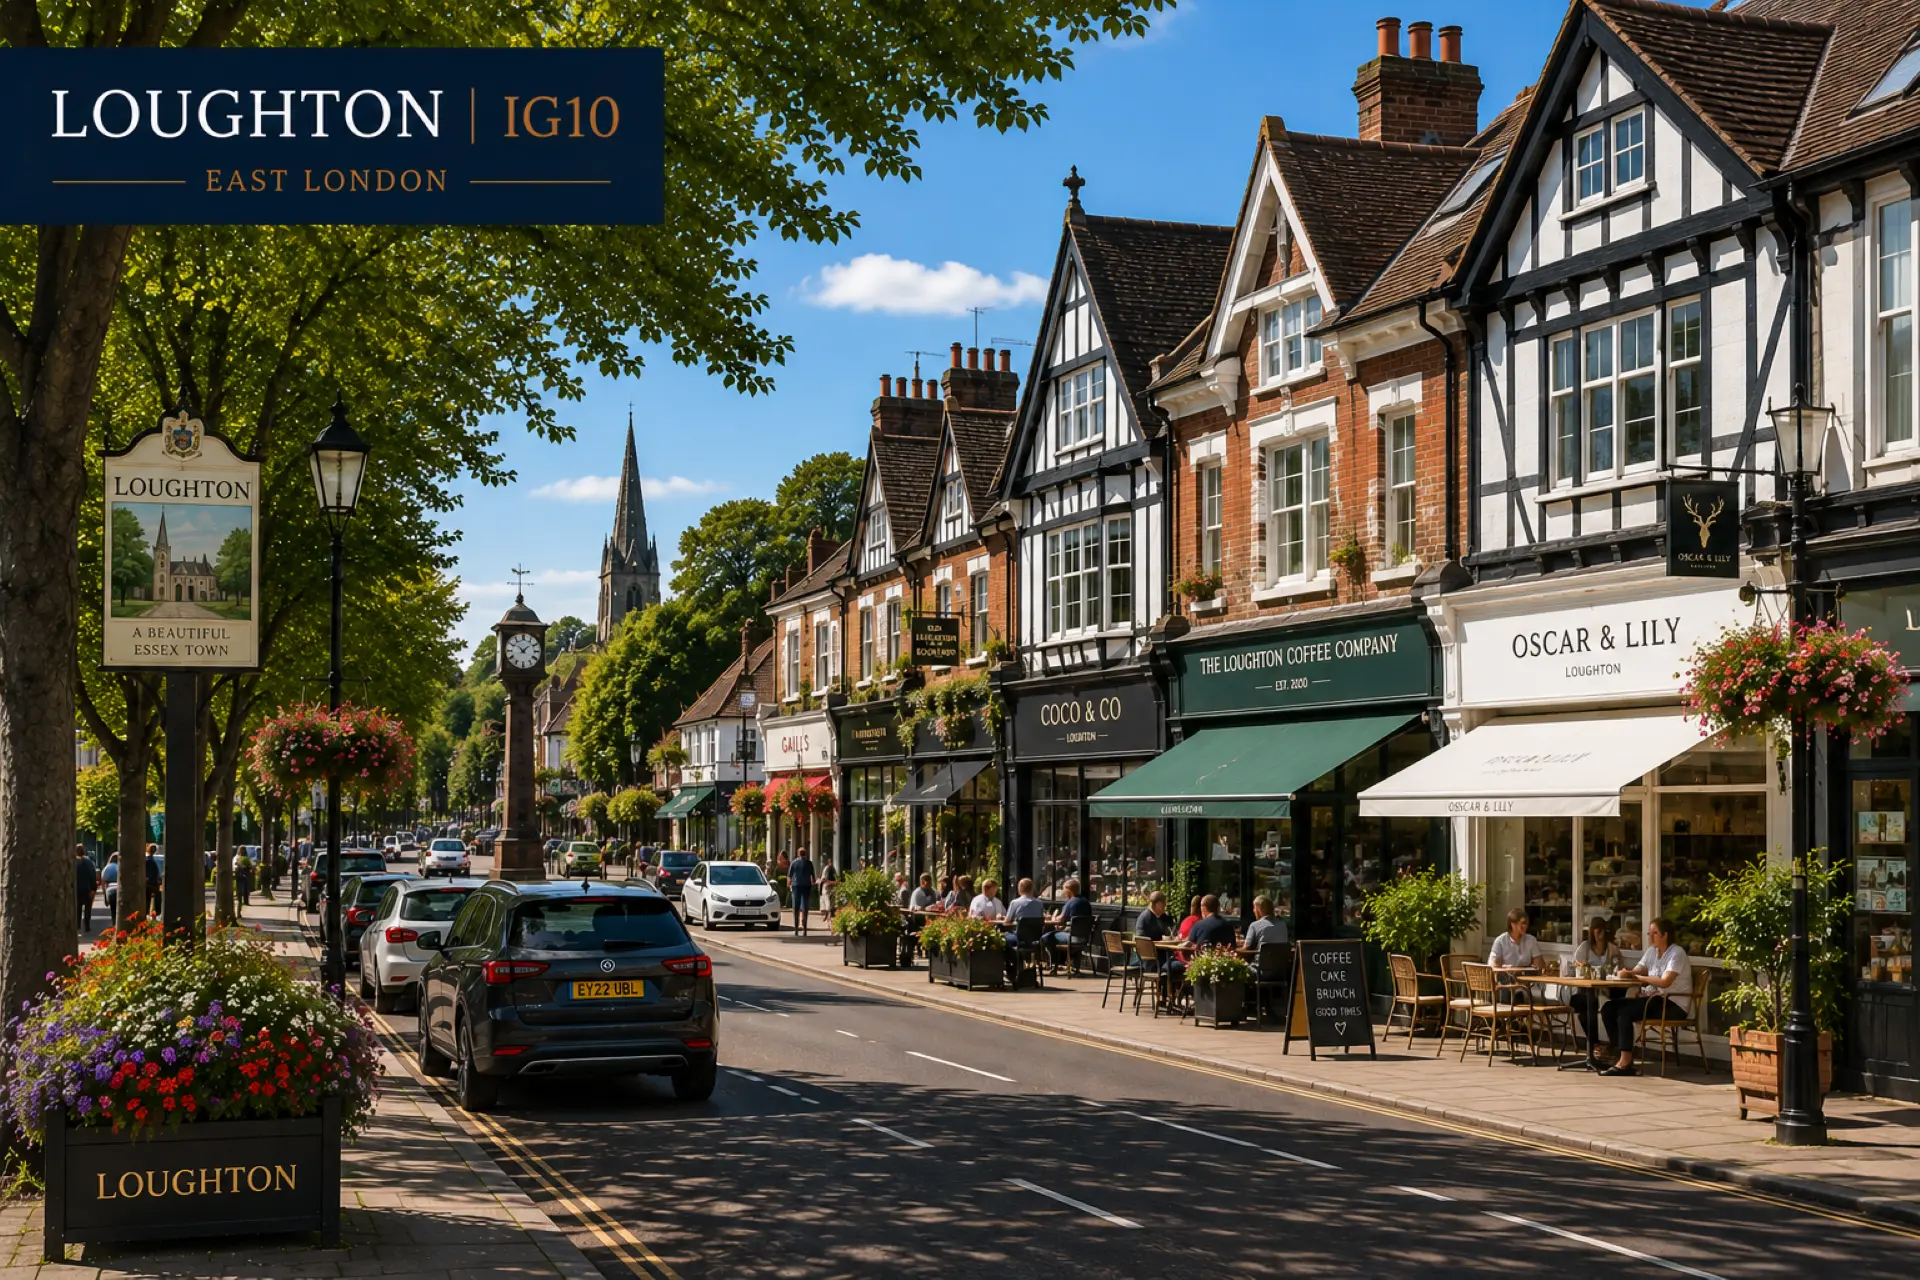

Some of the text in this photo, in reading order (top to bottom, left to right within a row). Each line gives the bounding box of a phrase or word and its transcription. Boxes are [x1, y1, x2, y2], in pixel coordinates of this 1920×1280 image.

[114, 476, 251, 499] LOUGHTON
[132, 627, 231, 639] A BEAUTIFUL
[1512, 616, 1681, 659] OSCAR & LILY
[134, 644, 229, 657] ESSEX TOWN
[1200, 633, 1399, 675] THE LOUGHTON COFFEE COMPANY
[1565, 663, 1621, 678] LOUGHTON
[1040, 696, 1122, 726] COCO & CO
[1311, 951, 1352, 965] COFFEE
[1320, 970, 1347, 982] CAKE
[577, 981, 638, 997] EY22 UBL
[1316, 987, 1356, 1000] BRUNCH
[96, 1164, 297, 1200] LOUGHTON
